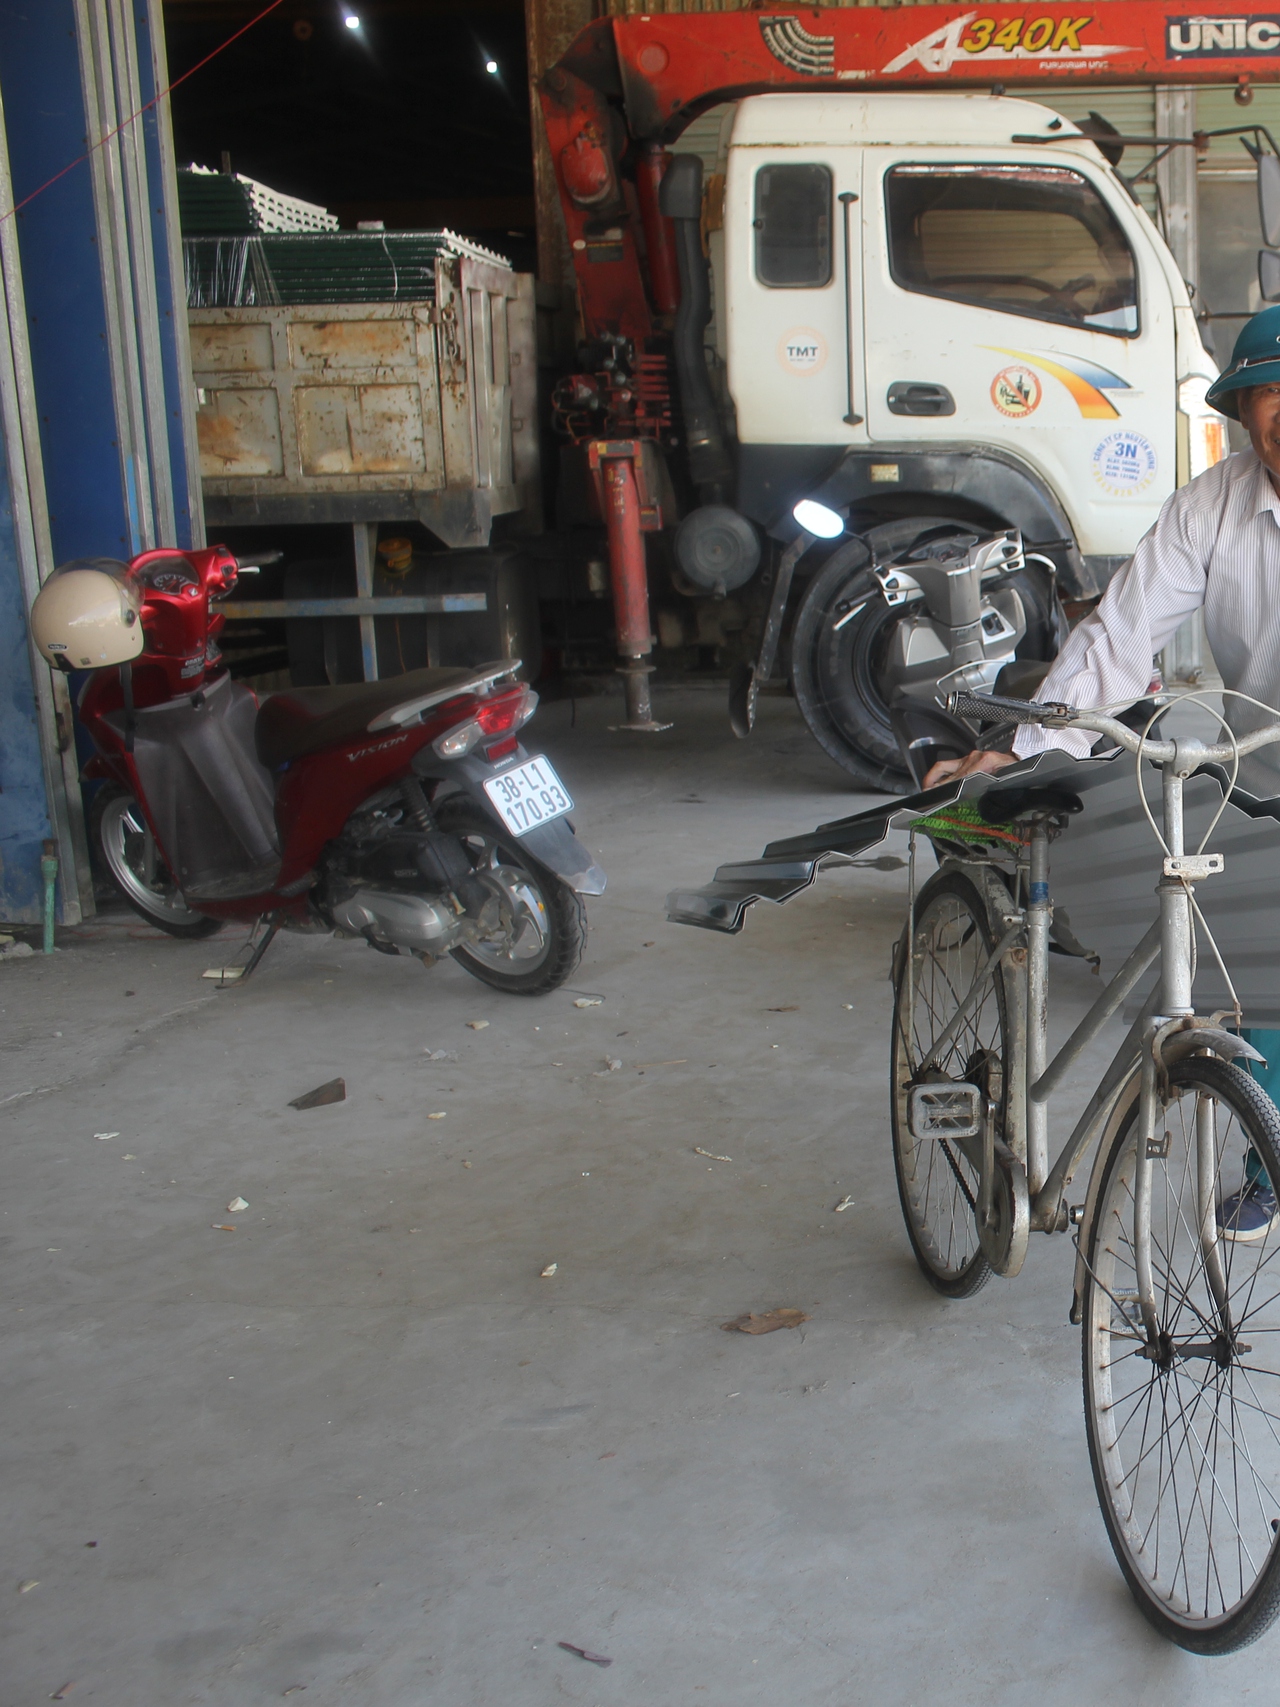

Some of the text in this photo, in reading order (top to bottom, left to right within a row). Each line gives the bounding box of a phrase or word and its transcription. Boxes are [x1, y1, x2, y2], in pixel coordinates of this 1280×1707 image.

[1169, 21, 1280, 52] UNIC
[787, 346, 818, 357] TMT
[1115, 442, 1138, 458] 3N
[495, 763, 547, 803] 38-L1
[506, 785, 567, 830] 170.93
